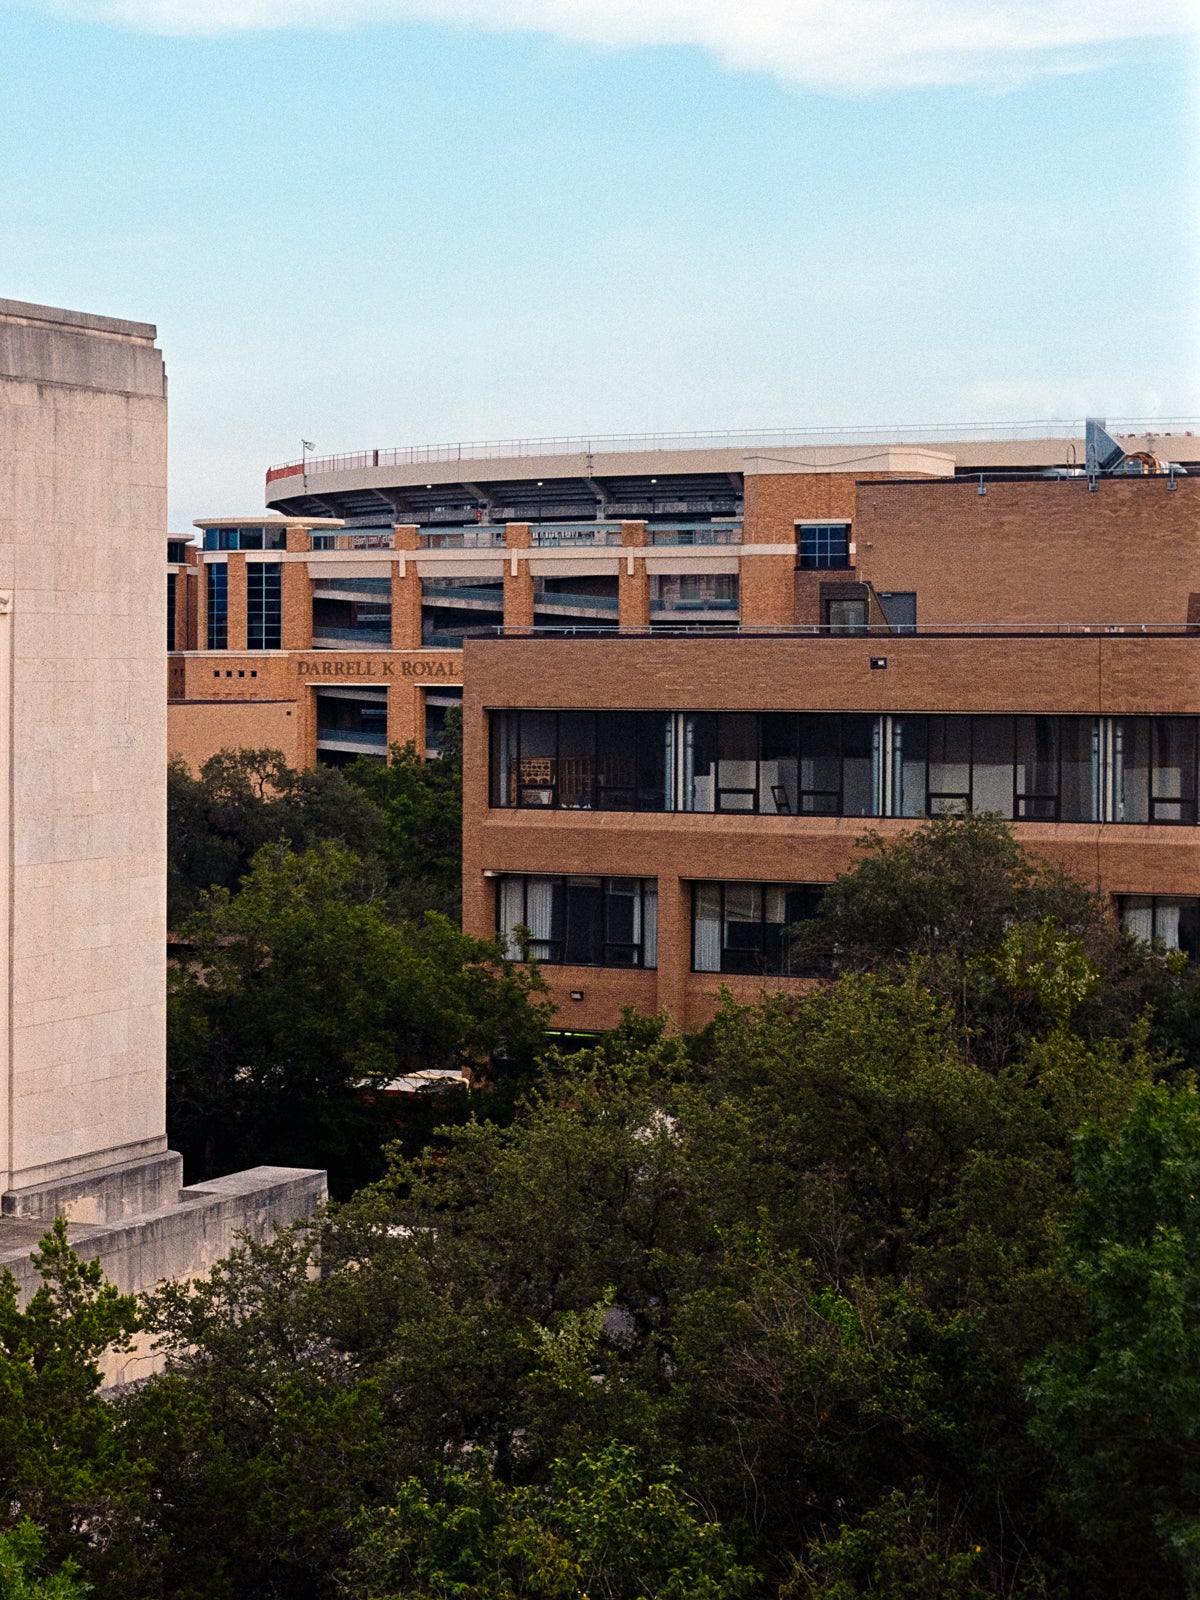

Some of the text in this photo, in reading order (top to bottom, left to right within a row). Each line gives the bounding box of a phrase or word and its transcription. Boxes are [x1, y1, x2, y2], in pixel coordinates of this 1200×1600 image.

[297, 661, 459, 676] DARRELL K ROYAL
